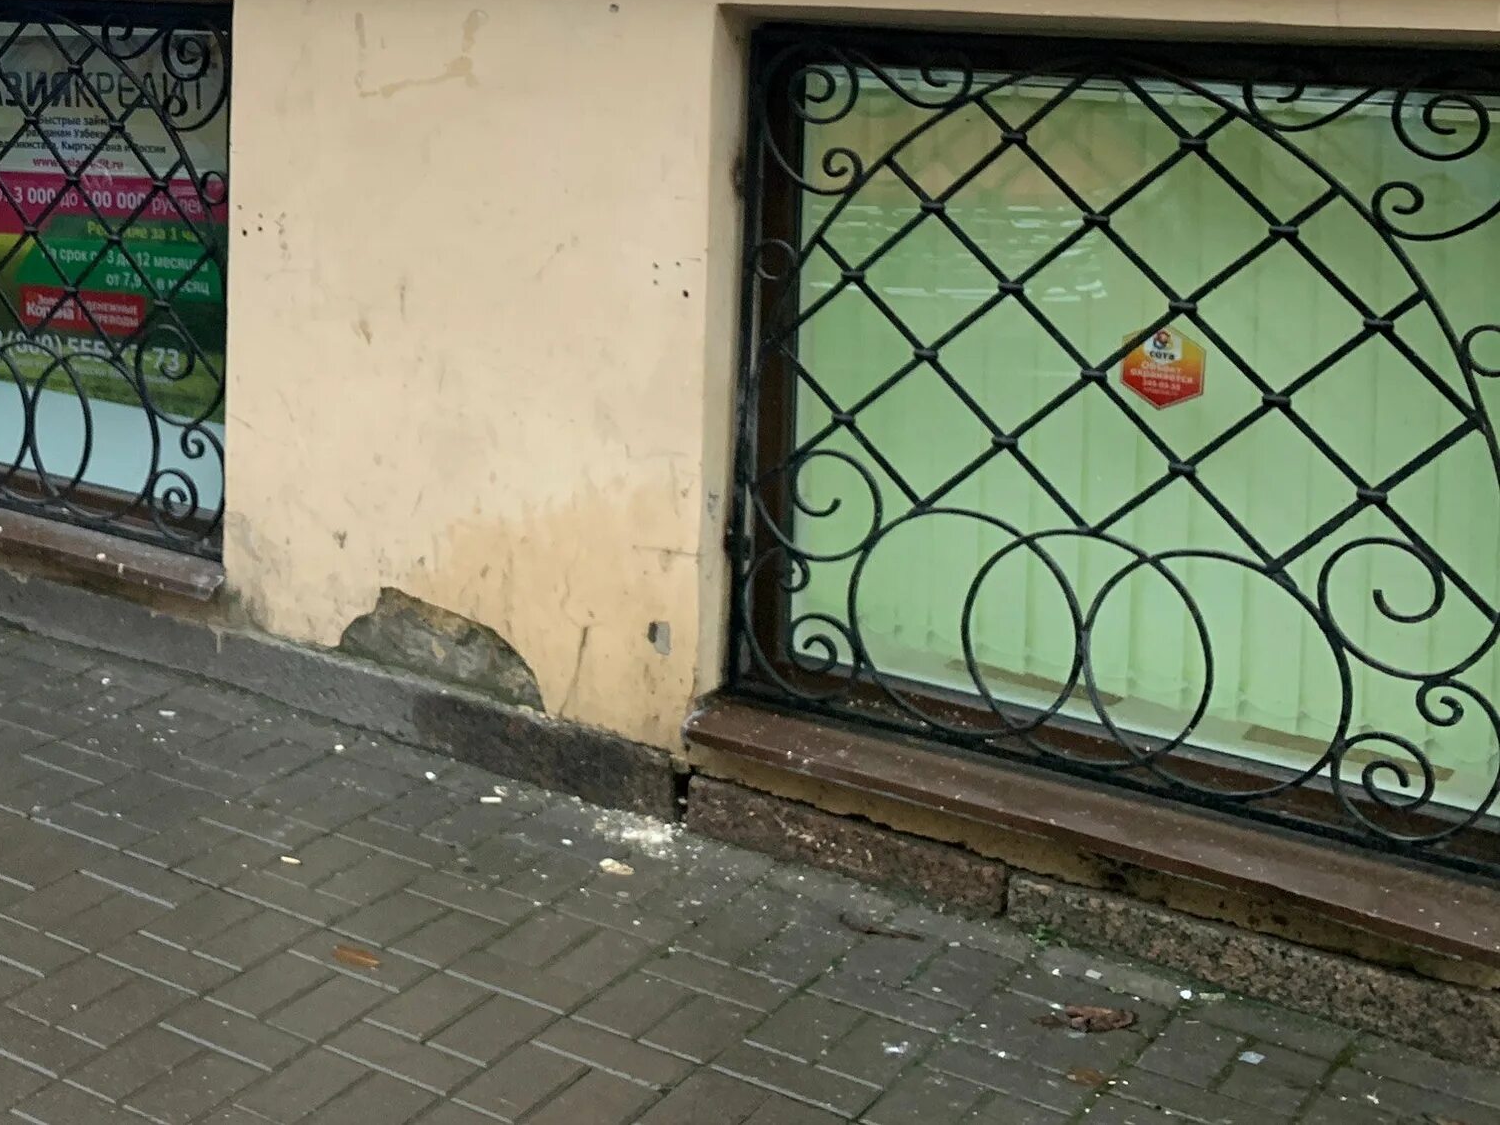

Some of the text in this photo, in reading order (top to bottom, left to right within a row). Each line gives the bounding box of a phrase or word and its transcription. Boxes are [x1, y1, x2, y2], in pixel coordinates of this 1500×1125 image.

[83, 114, 112, 127] займ
[14, 186, 23, 204] 3
[27, 186, 56, 207] 000
[60, 192, 78, 208] до
[83, 189, 112, 208] 00
[60, 248, 88, 264] срок
[106, 250, 114, 265] 3
[123, 272, 151, 290] 7,9
